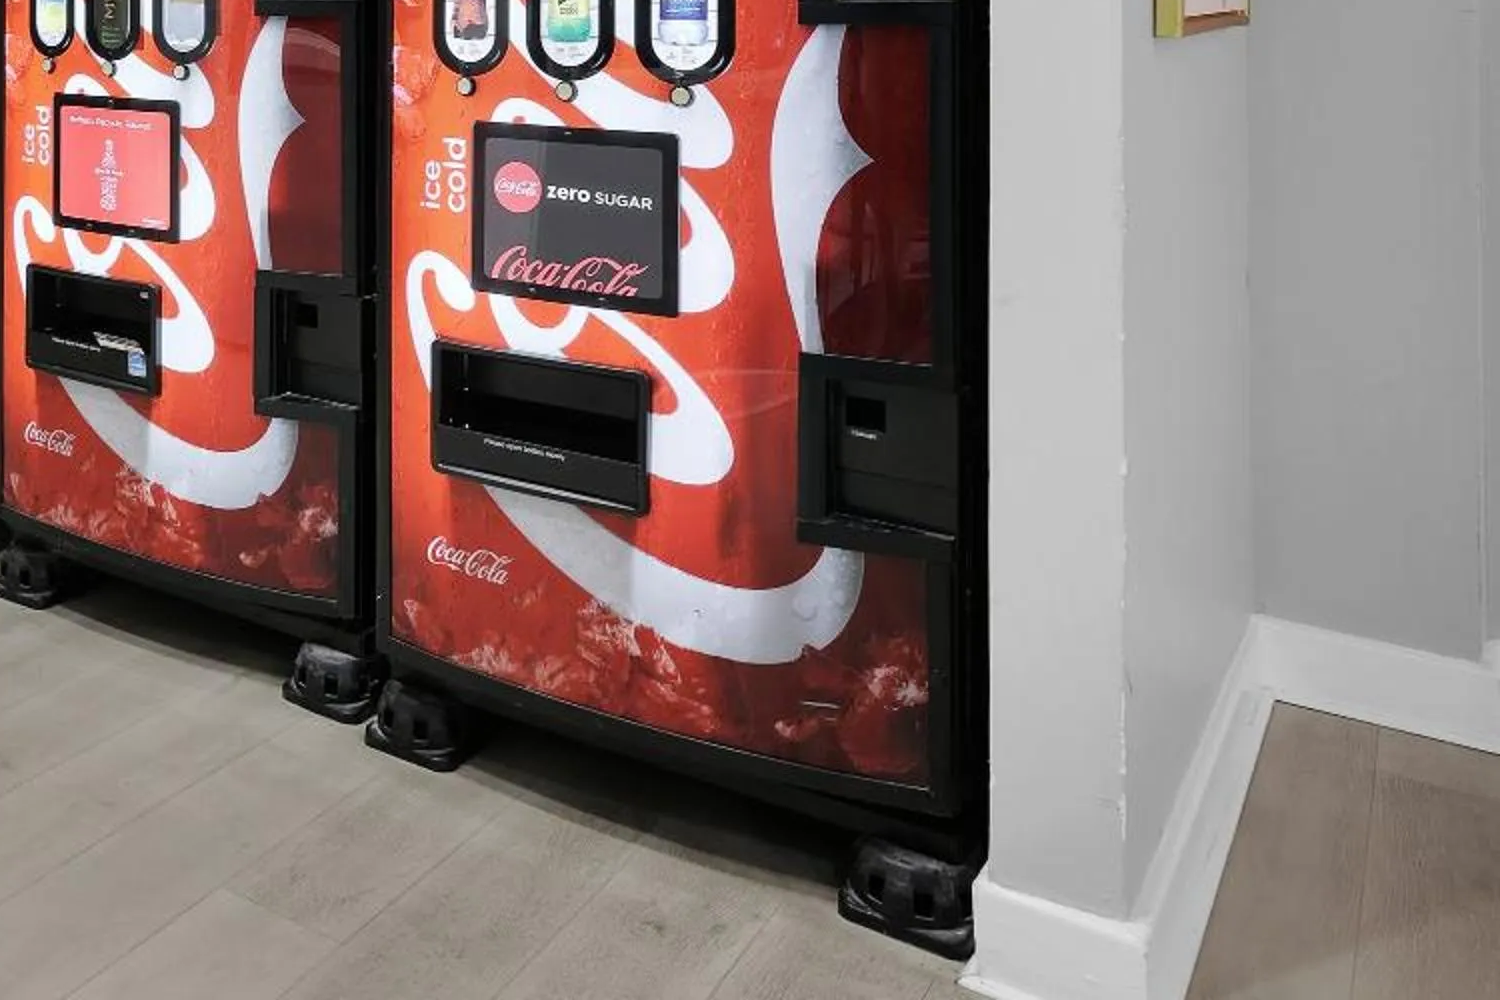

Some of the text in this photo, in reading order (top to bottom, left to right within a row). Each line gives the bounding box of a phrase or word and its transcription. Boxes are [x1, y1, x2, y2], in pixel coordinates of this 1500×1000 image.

[22, 124, 35, 164] ice
[36, 105, 51, 166] cold
[420, 160, 441, 209] ice
[443, 137, 467, 213] cold
[547, 185, 590, 203] zero
[595, 193, 653, 211] SUGAR
[427, 535, 516, 585] Coca-Cola
